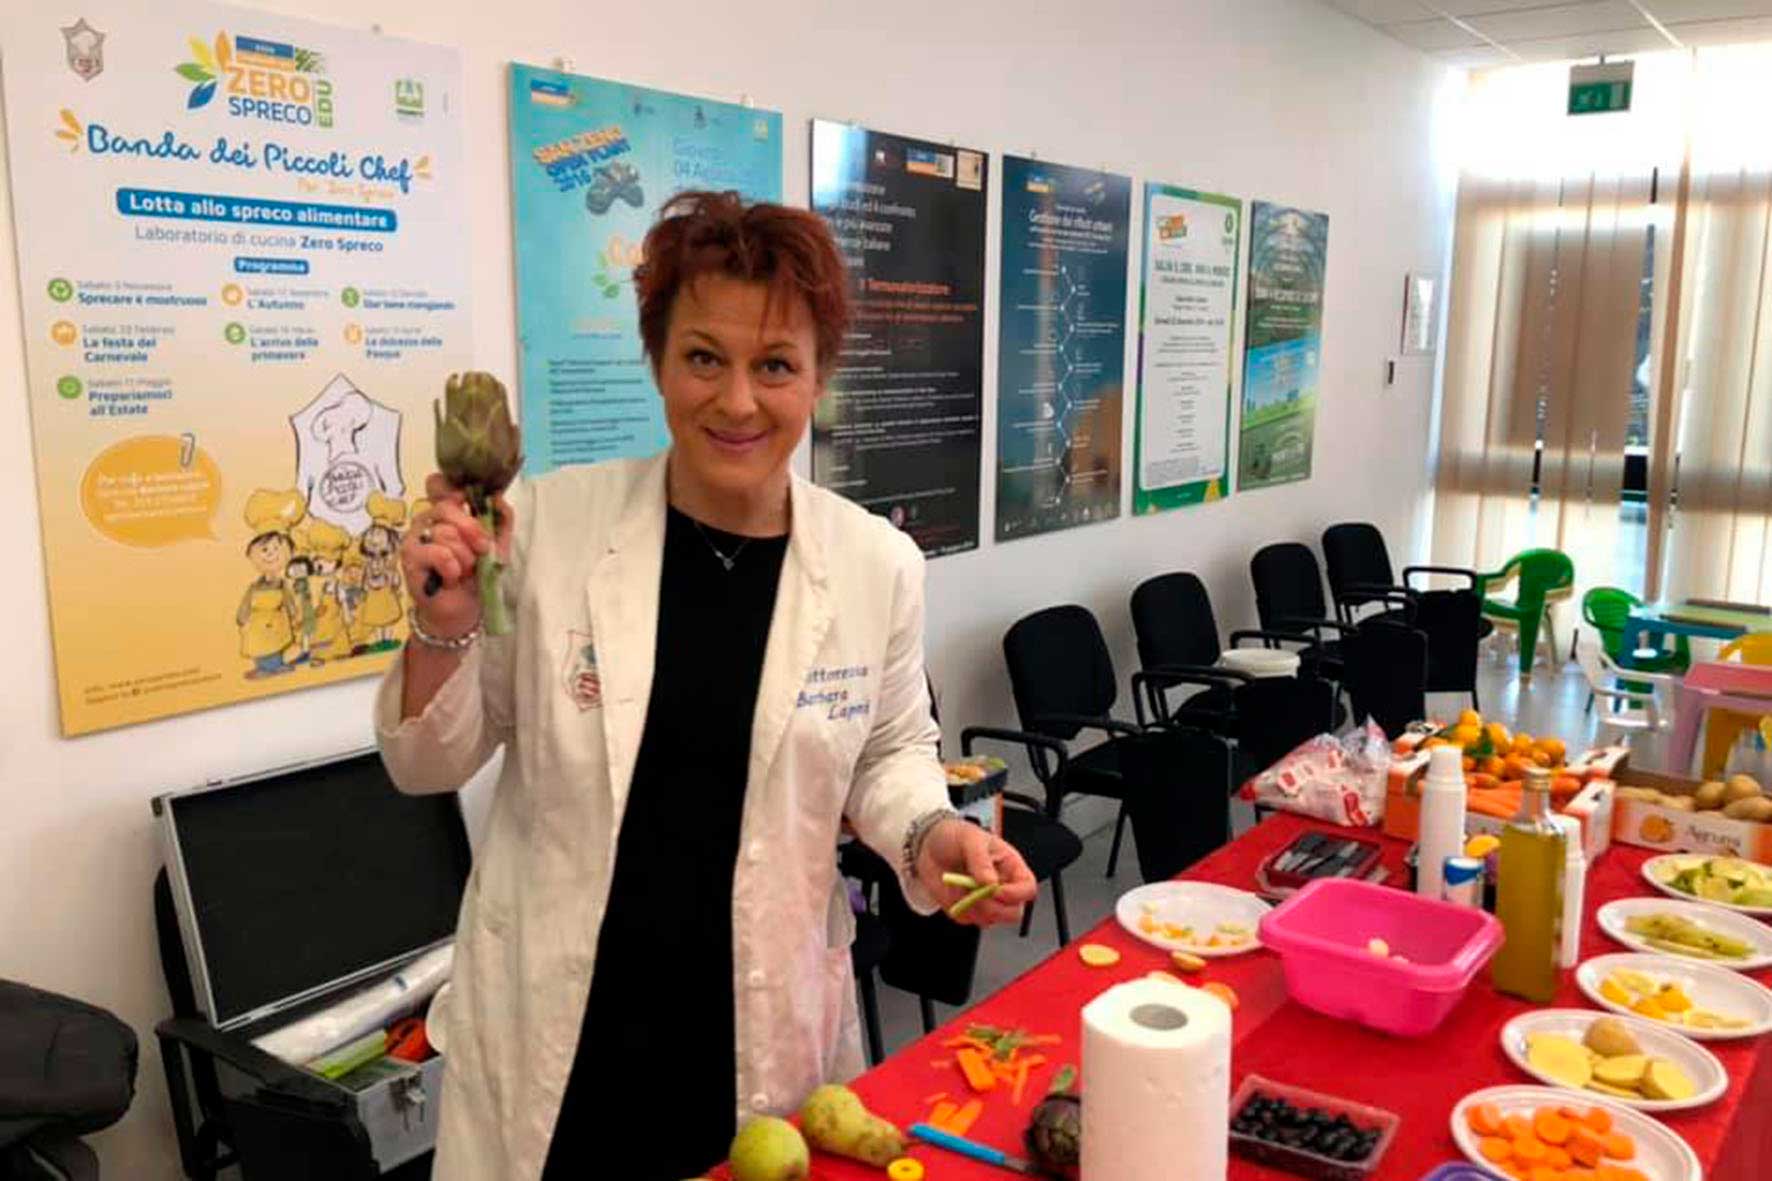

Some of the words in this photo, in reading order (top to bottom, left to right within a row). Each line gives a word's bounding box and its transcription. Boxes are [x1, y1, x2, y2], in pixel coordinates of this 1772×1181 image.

[228, 66, 310, 103] ZERO
[228, 96, 312, 125] SPRECO
[317, 80, 333, 127] EDU
[87, 124, 201, 160] Banda
[210, 137, 257, 168] dei
[264, 143, 353, 178] Piccoli
[359, 155, 412, 194] Chef
[130, 193, 184, 213] Lotta
[192, 199, 226, 216] allo
[232, 204, 292, 222] spreco
[297, 207, 388, 227] alimentare
[135, 226, 227, 245] Laboratorio
[232, 232, 246, 245] di
[250, 235, 296, 248] cucina
[301, 236, 333, 250] Zero
[337, 237, 384, 252] Spreco
[78, 292, 132, 305] Sprecare
[83, 338, 98, 348] La
[102, 338, 134, 348] festa
[84, 351, 149, 363] Carnevale
[89, 389, 173, 402] Prepariamoci
